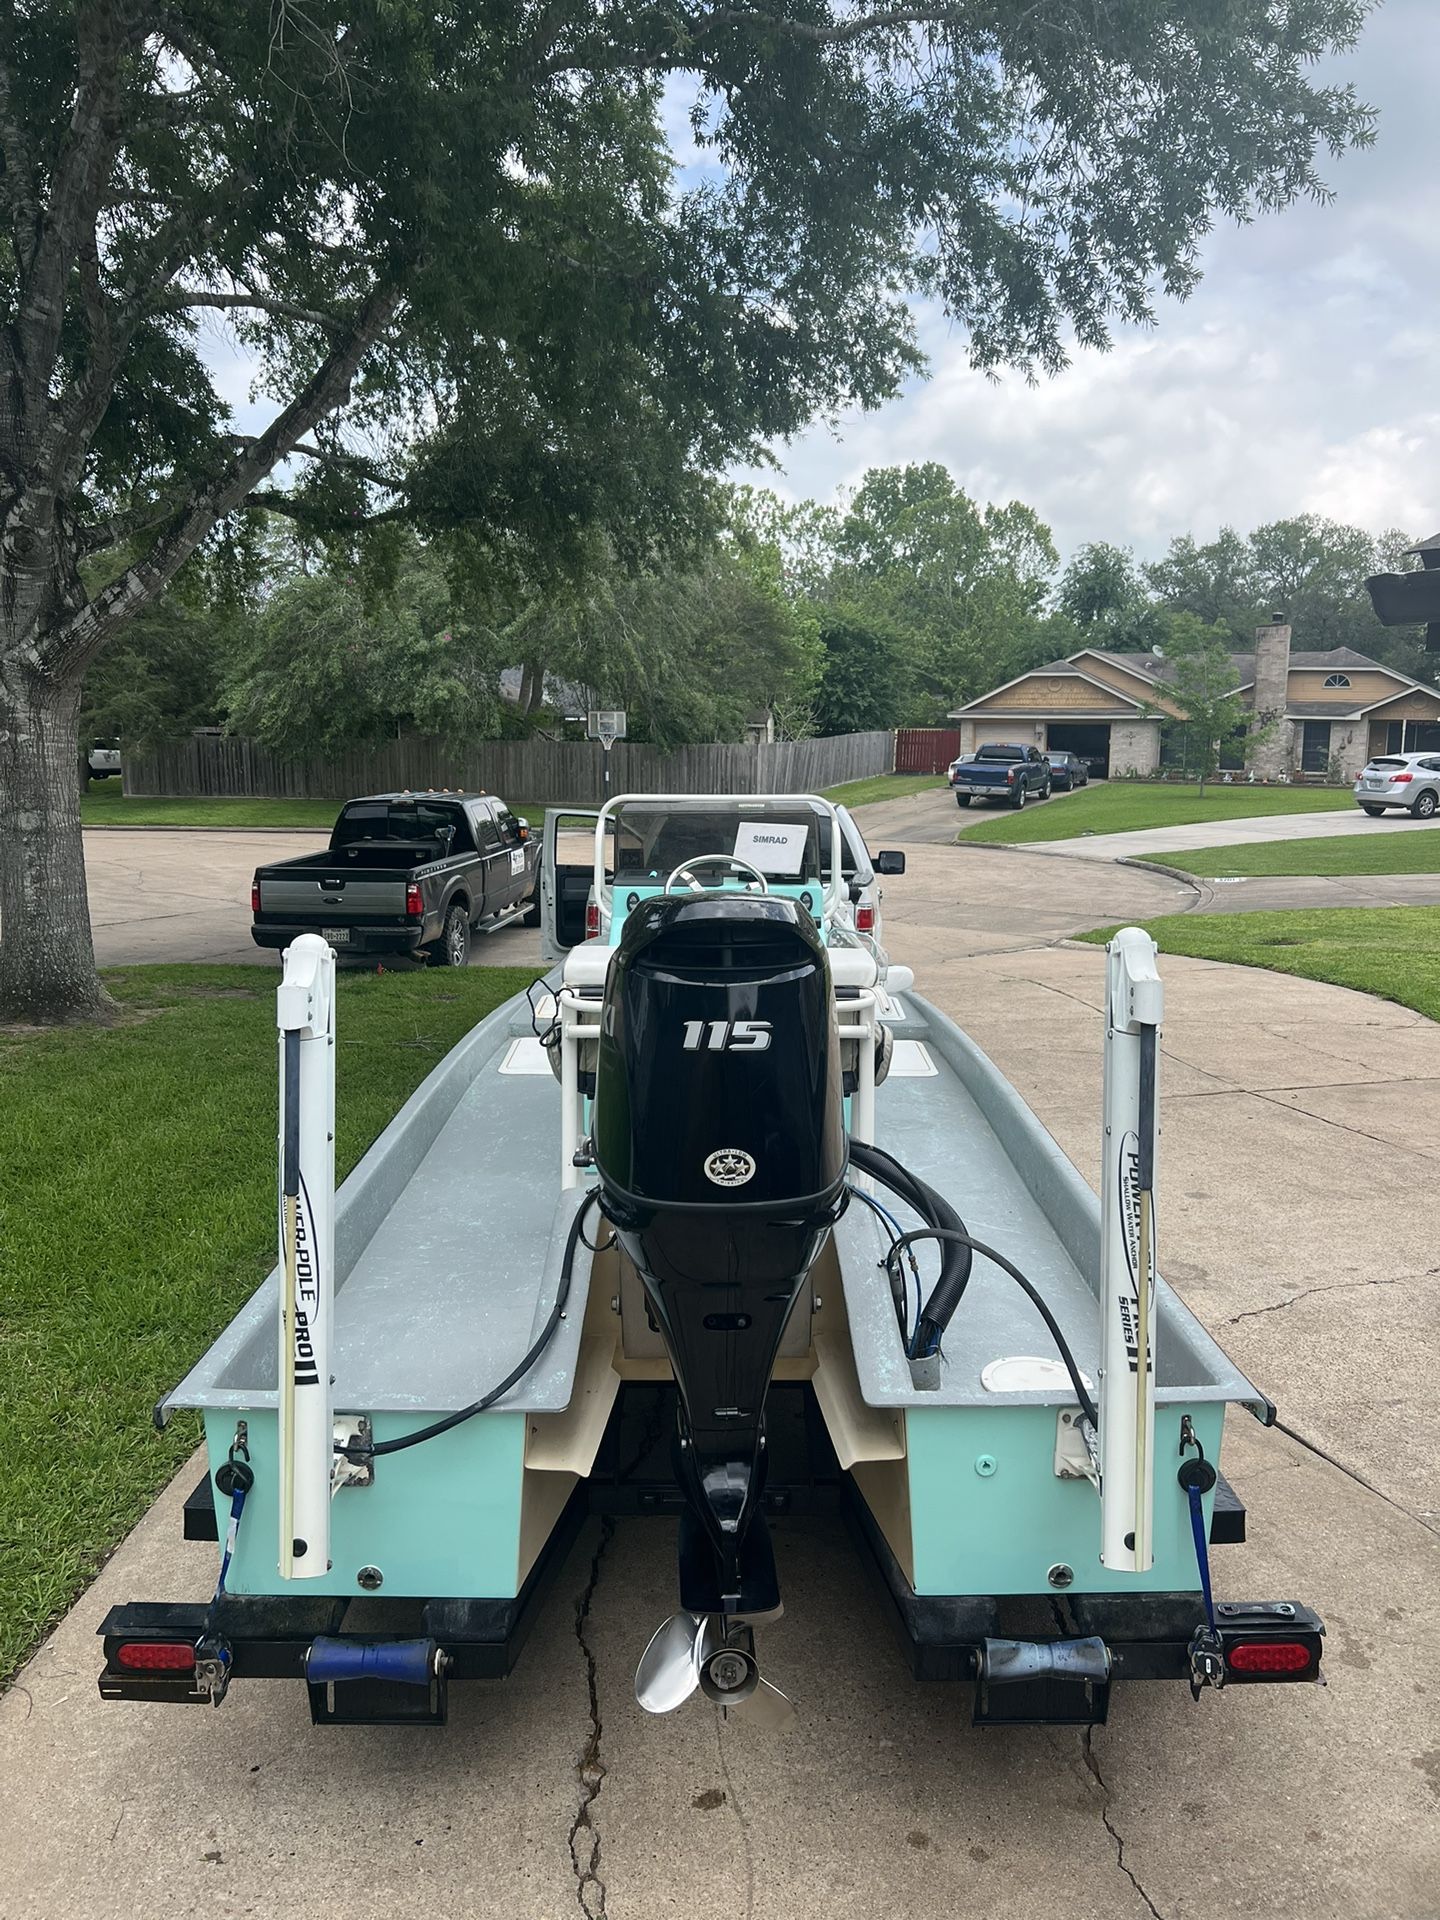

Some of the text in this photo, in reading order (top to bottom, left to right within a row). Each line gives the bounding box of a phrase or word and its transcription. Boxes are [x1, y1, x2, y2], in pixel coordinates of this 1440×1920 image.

[752, 834, 788, 845] SIMRAD
[682, 1020, 774, 1051] 115
[1122, 1176, 1138, 1269] SHALLOW WATER ANCHOR
[1118, 1296, 1135, 1344] SERIES
